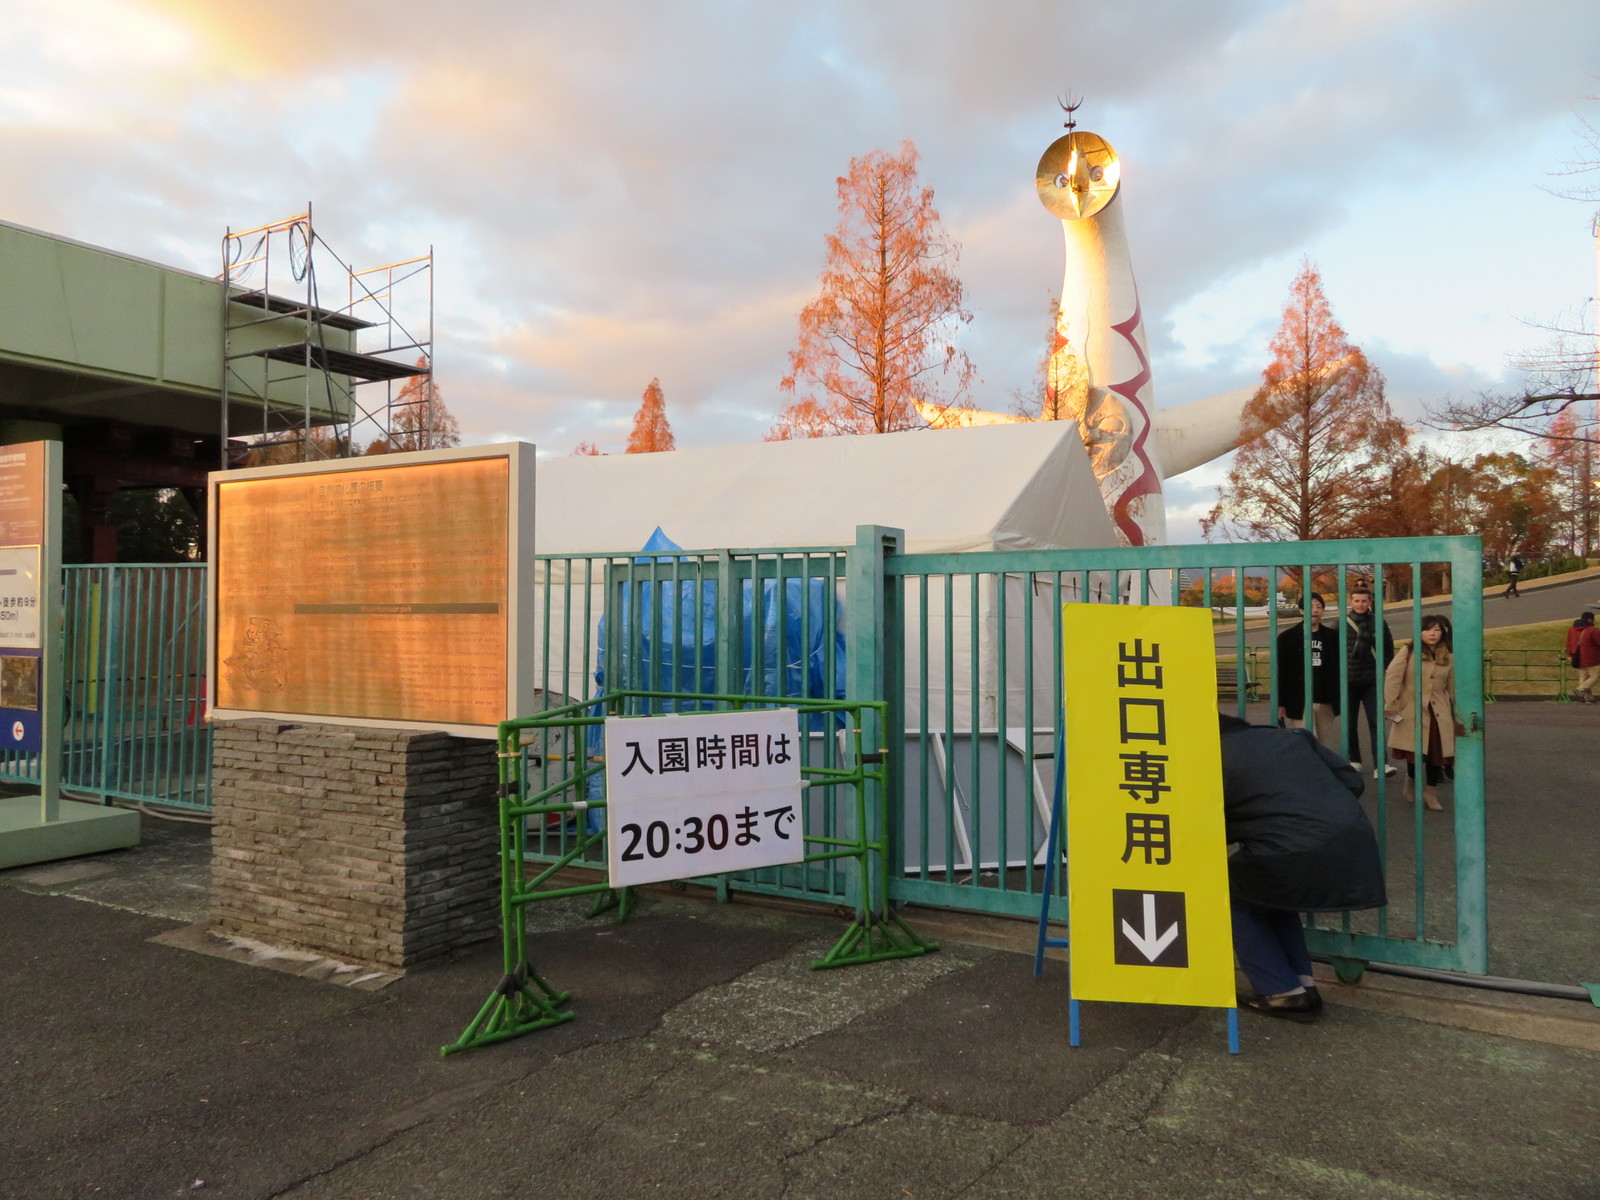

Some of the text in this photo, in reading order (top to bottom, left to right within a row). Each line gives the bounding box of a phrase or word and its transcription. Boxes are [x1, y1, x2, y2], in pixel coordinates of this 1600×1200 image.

[621, 733, 791, 777] 入園時間は
[1117, 638, 1172, 866] 出口専用
[621, 805, 796, 862] 20:30まで
